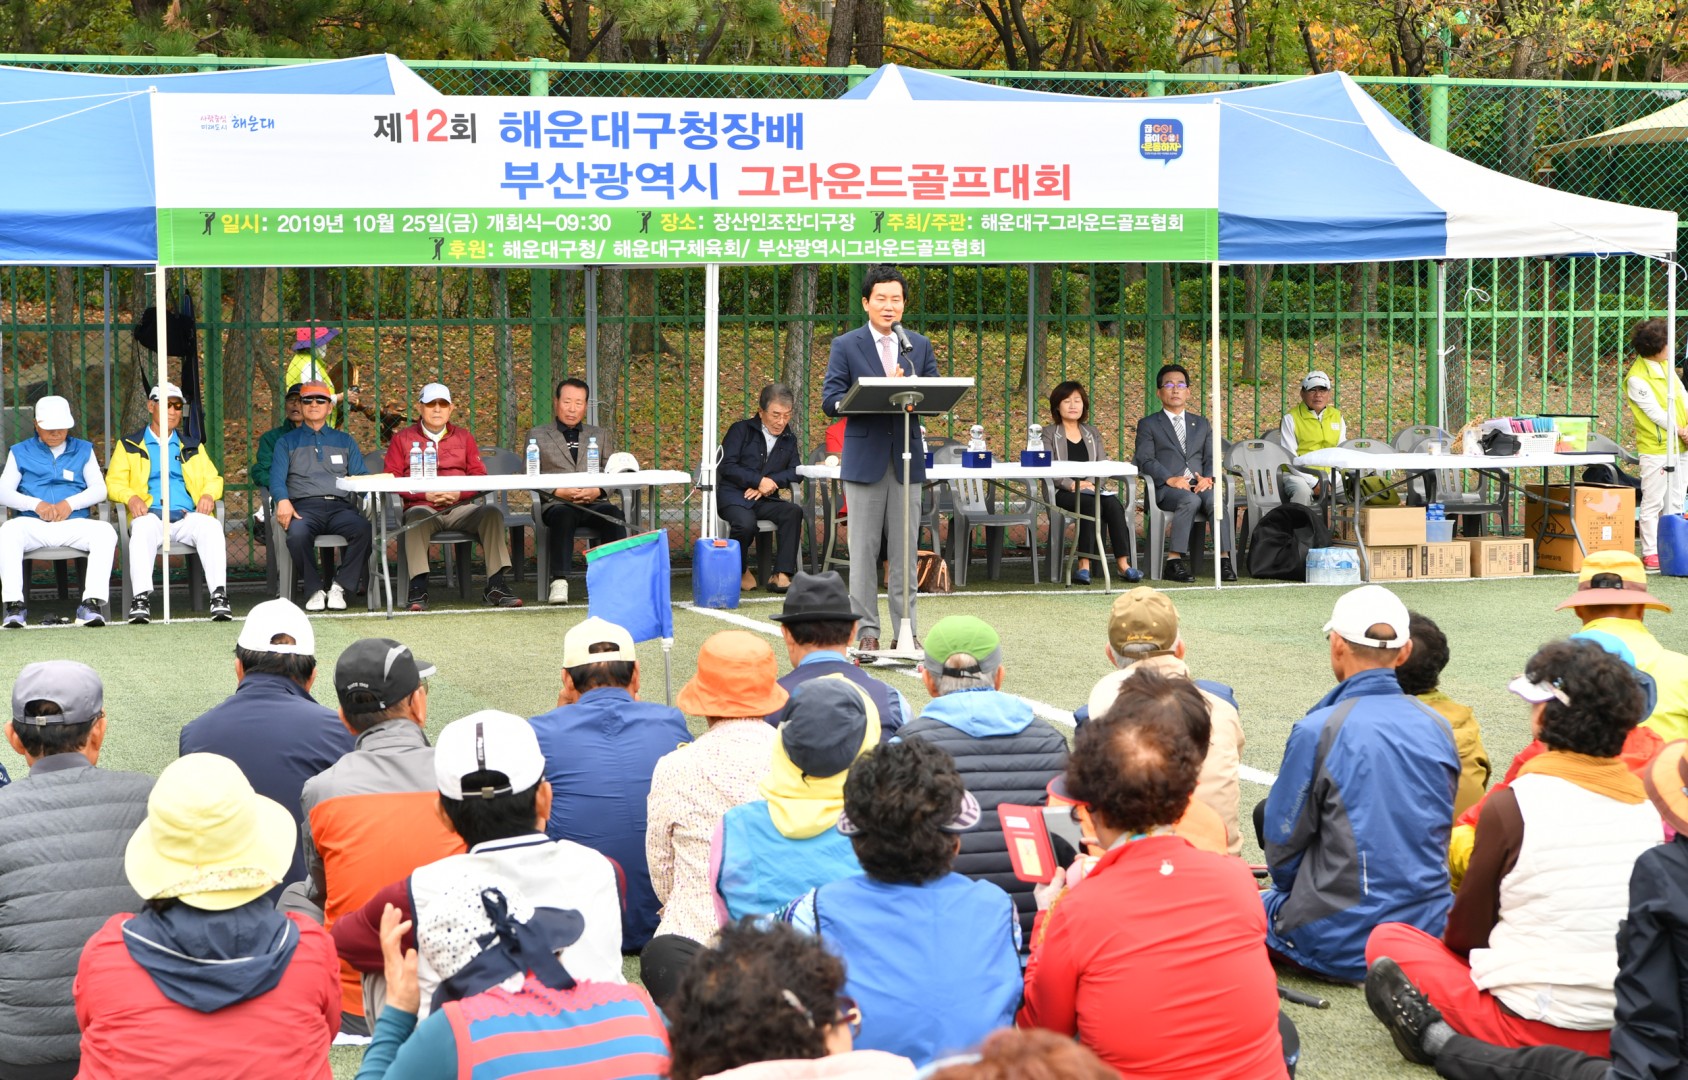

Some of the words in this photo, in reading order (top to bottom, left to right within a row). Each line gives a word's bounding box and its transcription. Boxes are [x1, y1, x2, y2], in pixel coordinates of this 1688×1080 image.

[231, 113, 275, 132] 해운대
[373, 108, 478, 144] 제12회
[499, 109, 804, 151] 해운대구청장배
[500, 161, 718, 201] 부산광역시
[738, 162, 1071, 201] 그라운드골프대회
[221, 213, 268, 234] 일시:
[277, 213, 344, 234] 2019년
[353, 212, 395, 234] 10월
[402, 212, 479, 234] 25일(금)
[659, 212, 704, 233] 장소:
[712, 212, 857, 233] 장산인조잔디구장
[887, 212, 973, 233] 주최/주관:
[980, 212, 1184, 232] 해운대구그라운드골프협회
[448, 238, 495, 260] 후원:
[502, 238, 607, 260] 해운대구청/
[613, 238, 751, 259] 해운대구체육회/
[757, 238, 986, 259] 부산광역시그라운드골프협회
